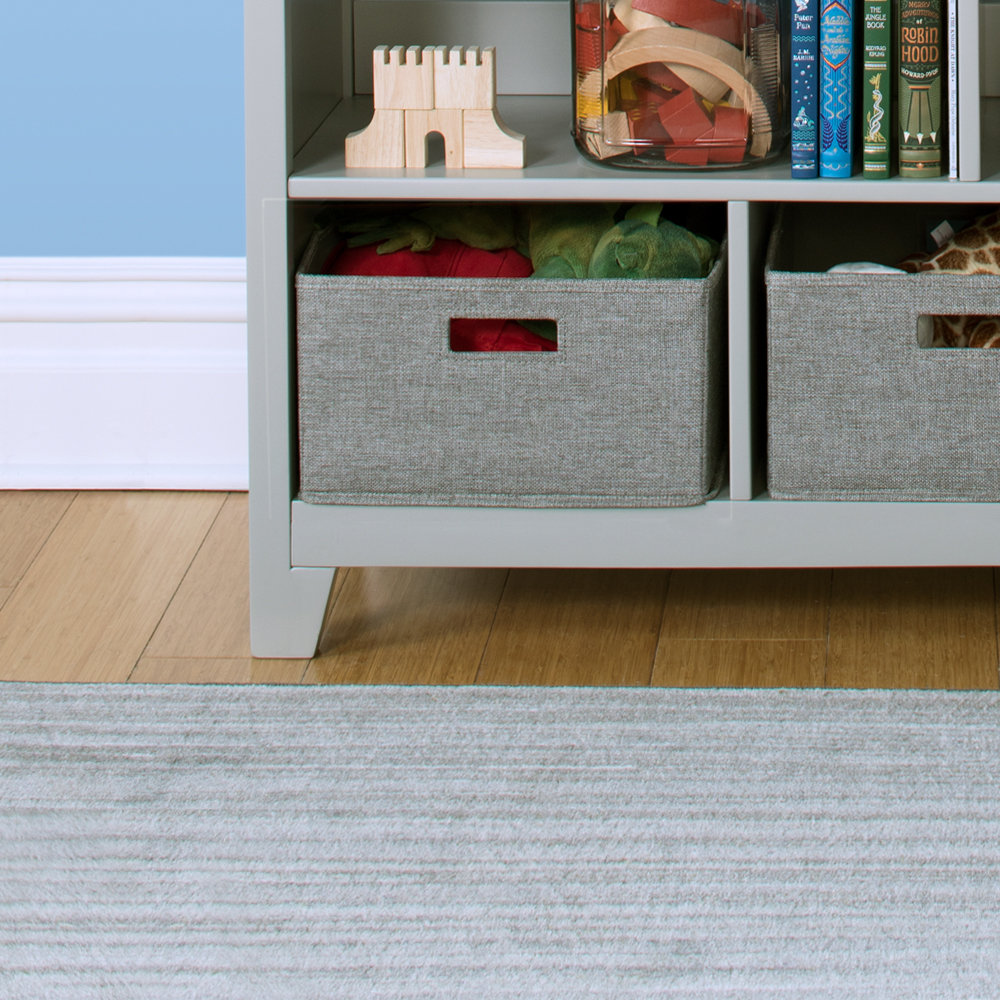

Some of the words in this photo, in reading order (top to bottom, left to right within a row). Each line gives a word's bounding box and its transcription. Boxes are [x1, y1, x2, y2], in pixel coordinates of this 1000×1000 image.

[794, 13, 814, 21] Peter
[796, 21, 811, 30] Pan
[866, 21, 885, 29] BOOK
[901, 45, 939, 63] HOOD
